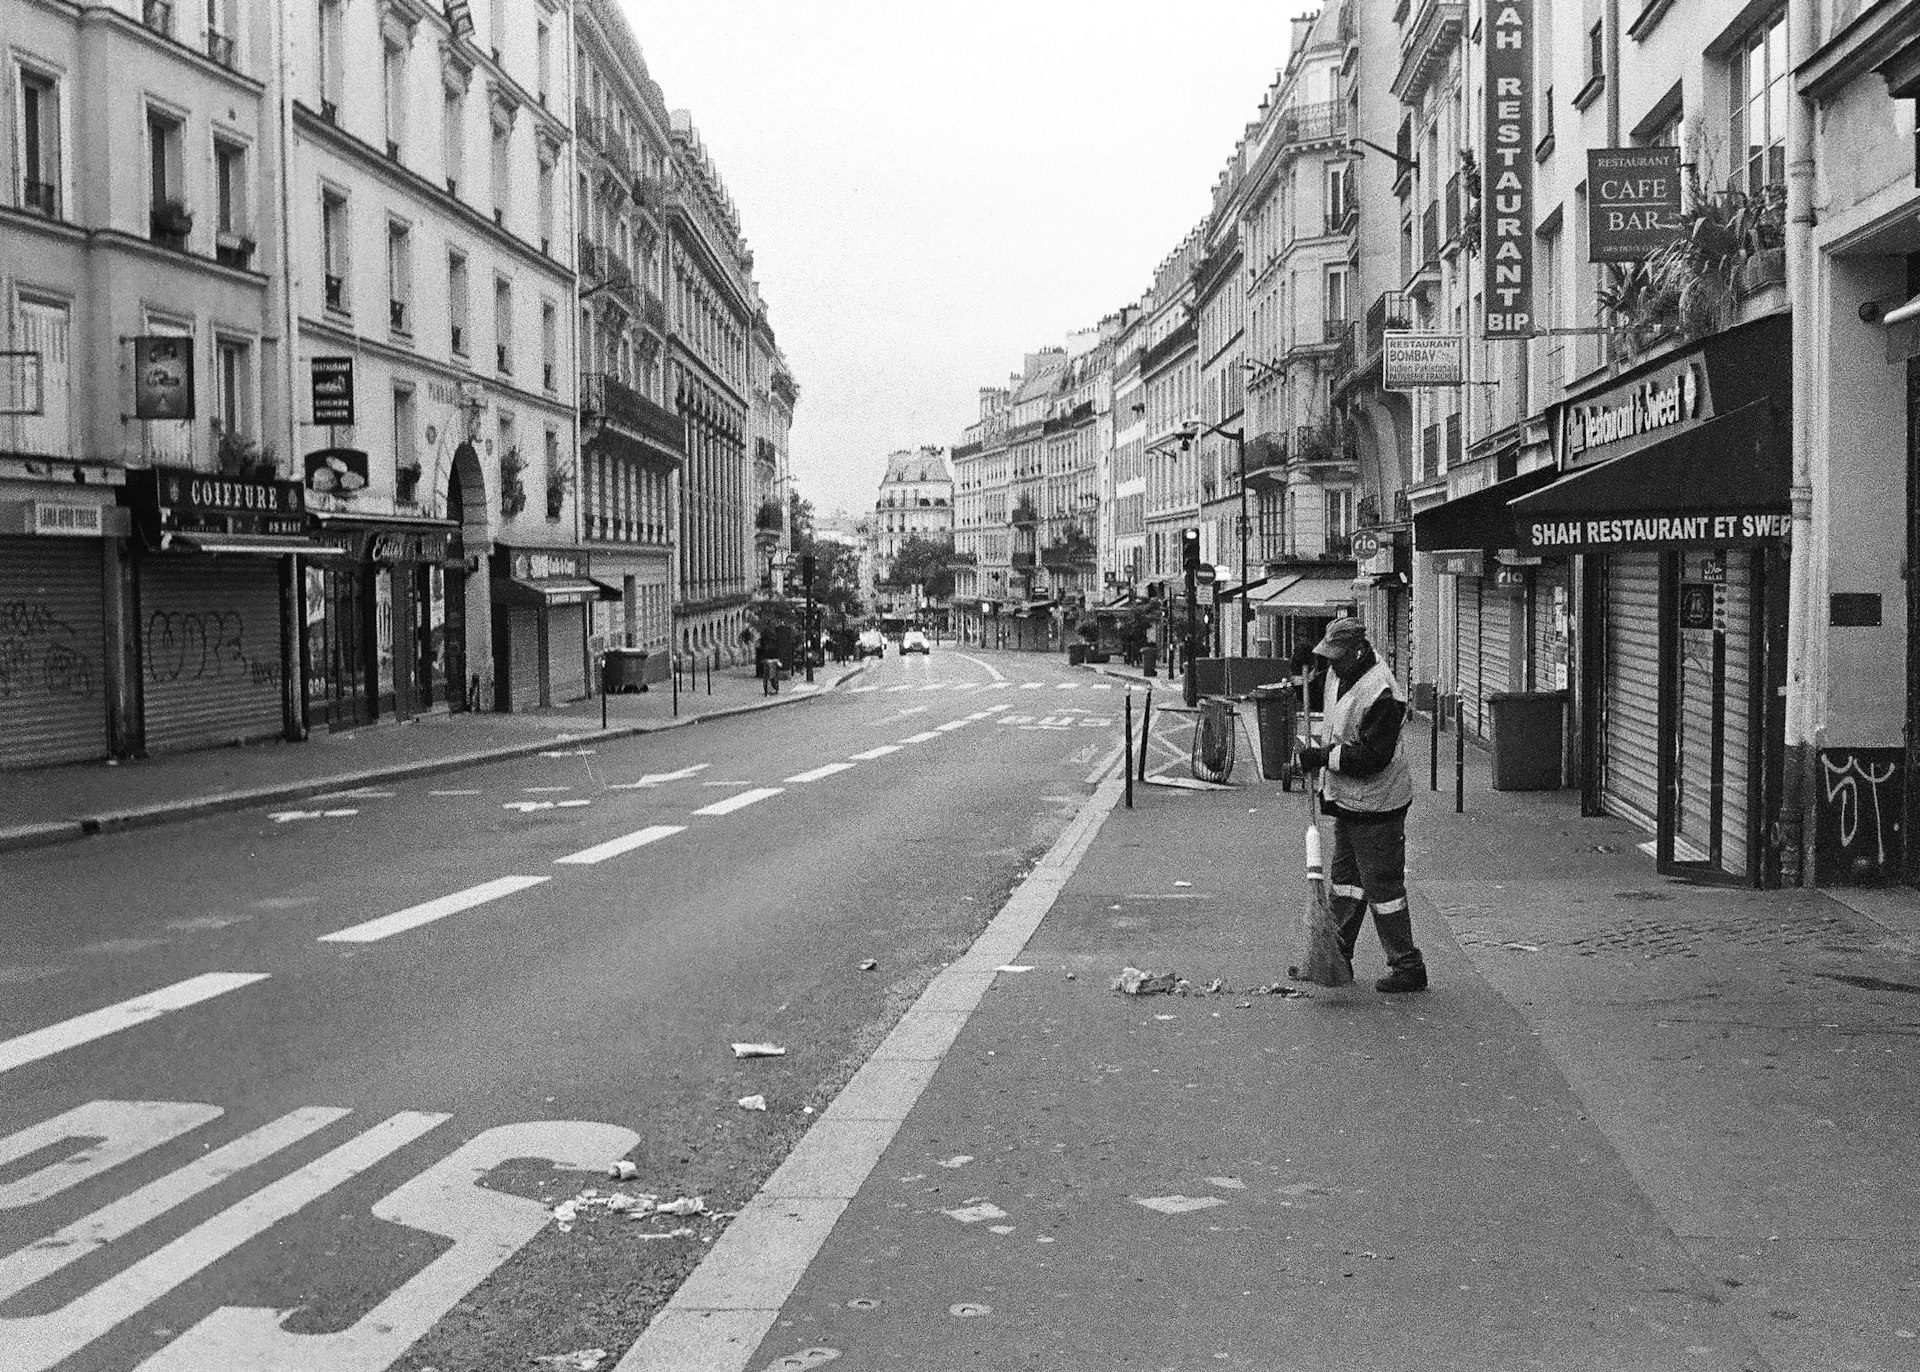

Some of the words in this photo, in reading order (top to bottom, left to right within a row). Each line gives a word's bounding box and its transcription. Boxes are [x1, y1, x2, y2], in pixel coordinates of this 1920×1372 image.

[1495, 0, 1523, 49] AH
[1598, 156, 1669, 168] RESTAURANT
[1495, 77, 1523, 307] RESTAURANT
[1601, 179, 1667, 200] CAFE
[1609, 210, 1660, 231] BAR
[1488, 313, 1529, 331] BIP
[1390, 340, 1457, 348] RESTAURANT
[1390, 349, 1436, 361] BOMBAY
[1644, 376, 1680, 431] Sweet
[191, 480, 278, 510] COIFFURE
[1532, 522, 1581, 546] SHAH
[1587, 517, 1708, 543] RESTAURANT
[1714, 516, 1737, 538] ET
[1354, 534, 1377, 550] ria
